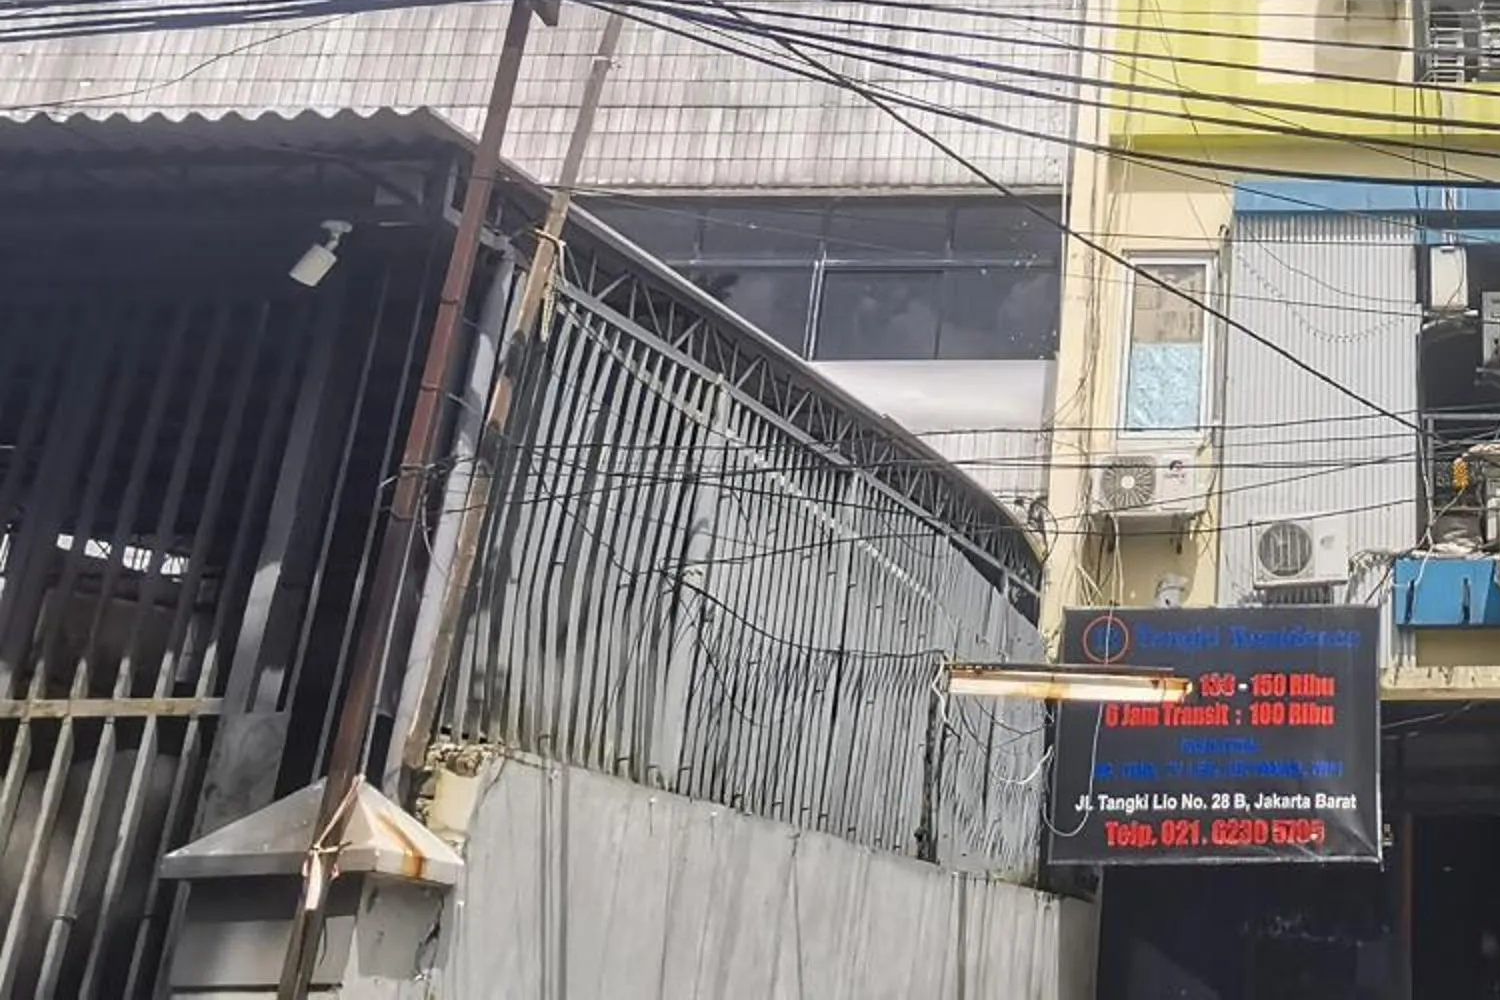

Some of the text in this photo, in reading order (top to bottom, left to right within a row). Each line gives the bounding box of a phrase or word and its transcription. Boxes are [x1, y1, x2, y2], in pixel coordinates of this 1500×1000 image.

[1251, 673, 1286, 696] 150
[1289, 673, 1335, 696] Ribu
[1121, 703, 1159, 726] Jam
[1162, 700, 1229, 726] Transit
[1249, 702, 1285, 726] 100
[1289, 702, 1334, 726] Ribu
[1098, 794, 1149, 815] Tangki
[1153, 793, 1178, 809] Lio
[1181, 793, 1207, 809] No.
[1211, 792, 1231, 809] 28
[1234, 793, 1250, 811] B,
[1254, 792, 1311, 809] Jakarta
[1315, 793, 1357, 809] Barat
[1105, 820, 1158, 847] Telp.
